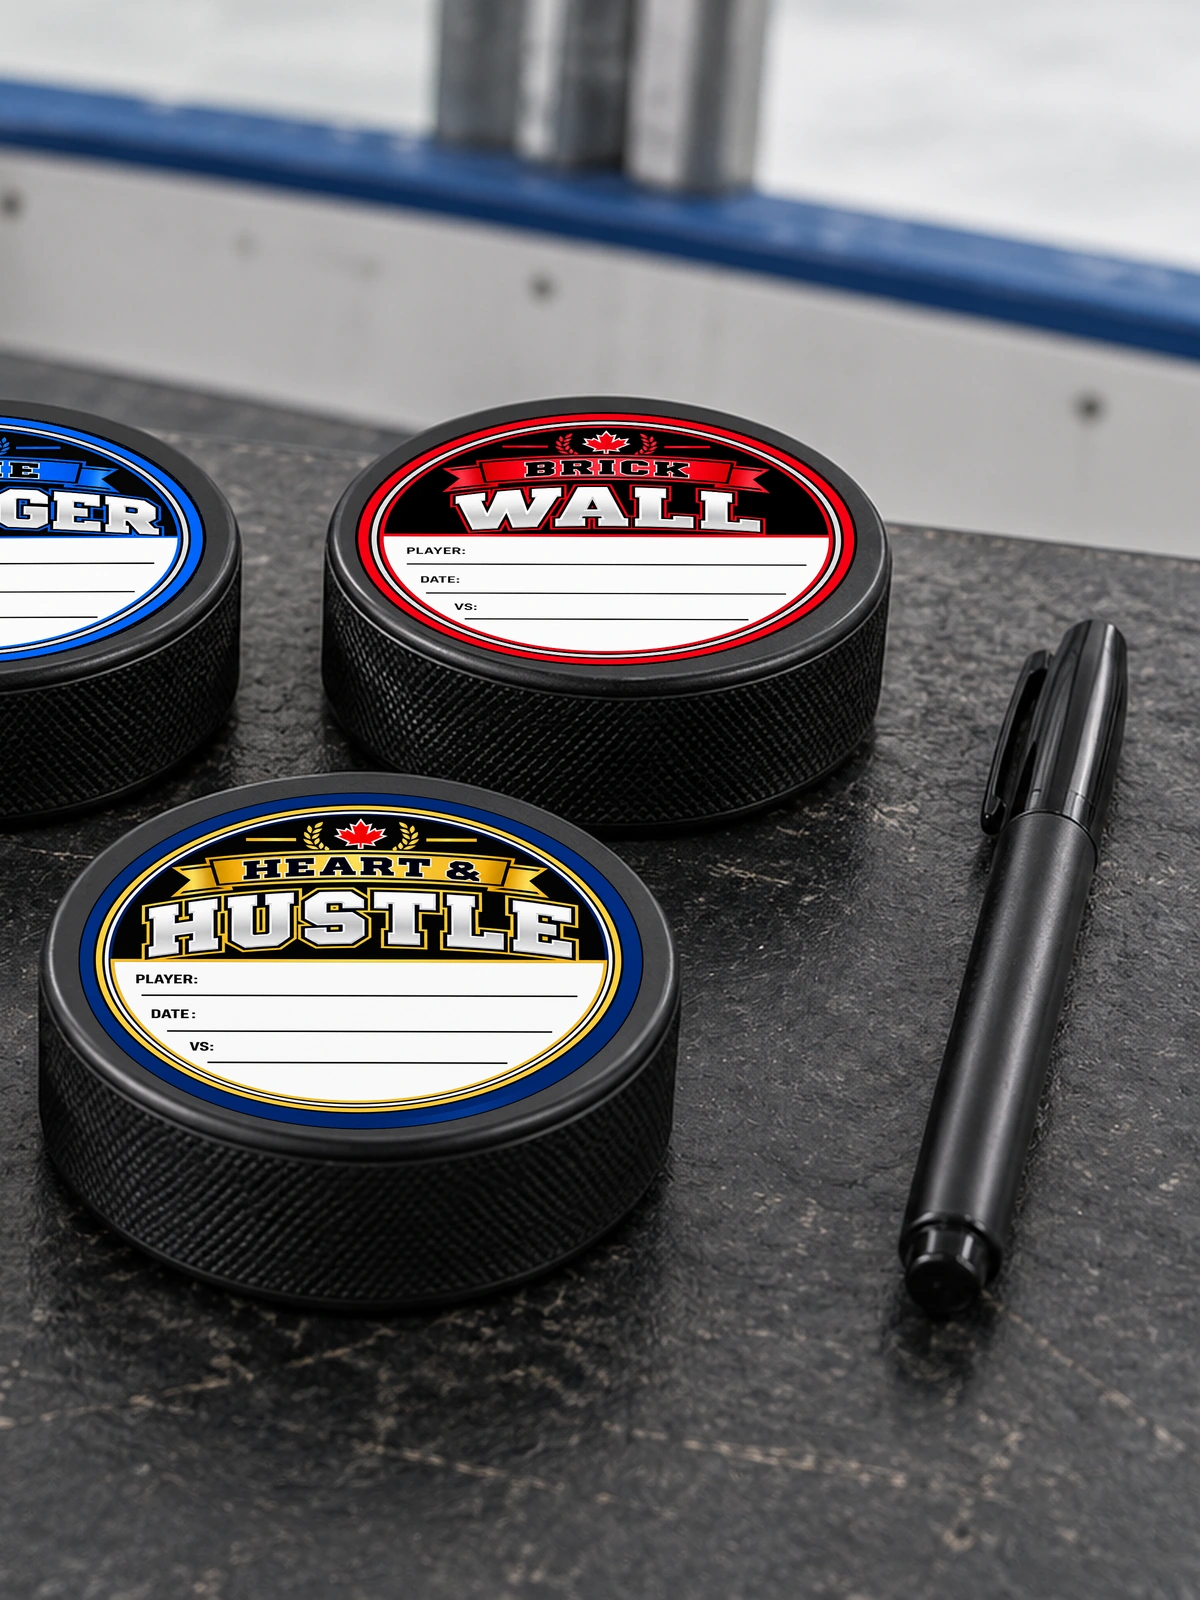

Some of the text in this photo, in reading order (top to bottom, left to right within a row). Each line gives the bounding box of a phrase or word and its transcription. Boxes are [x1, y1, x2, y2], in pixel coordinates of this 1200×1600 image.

[524, 459, 690, 479] BRICK
[455, 486, 762, 532] WALL
[406, 546, 466, 555] PLAYER:
[420, 575, 460, 584] DATE:
[454, 602, 477, 611] VS:
[243, 856, 481, 881] HEART &
[146, 891, 575, 959] HUSTLE
[135, 973, 198, 985] PLAYER:
[151, 1008, 196, 1019] DATE:
[189, 1041, 214, 1052] VS:
